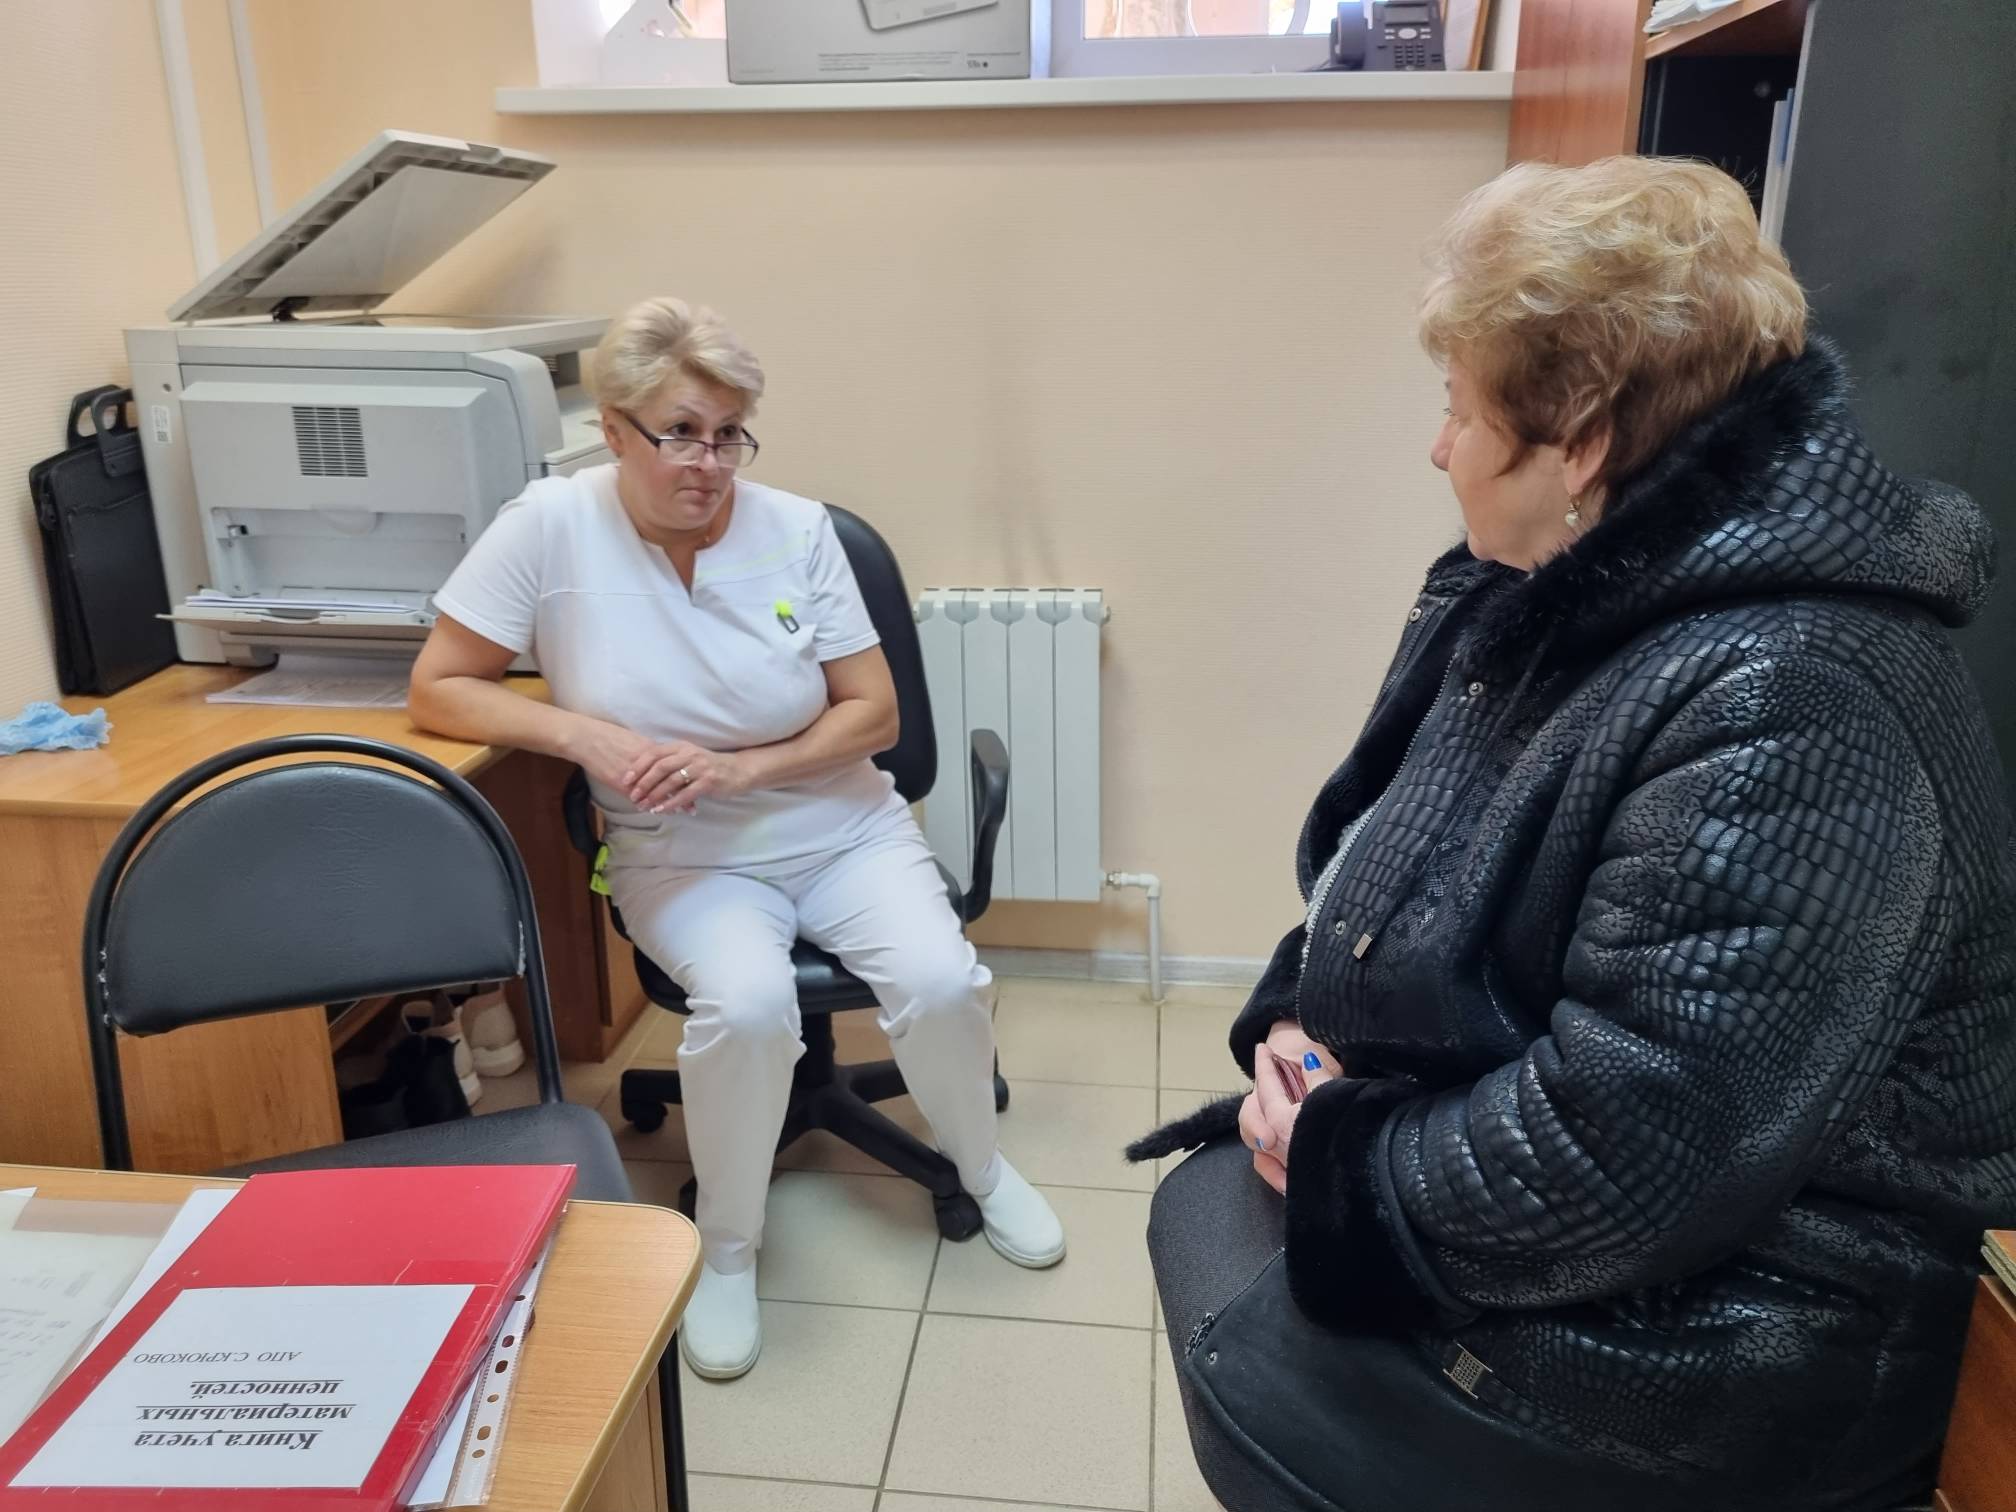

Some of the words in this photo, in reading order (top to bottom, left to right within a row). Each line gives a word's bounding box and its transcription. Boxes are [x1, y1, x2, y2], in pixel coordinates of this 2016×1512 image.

[257, 1351, 302, 1362] АПО
[189, 1381, 341, 1399] ценностей.
[136, 1402, 355, 1420] материальных
[134, 1429, 224, 1448] учета
[224, 1432, 320, 1450] Книга
